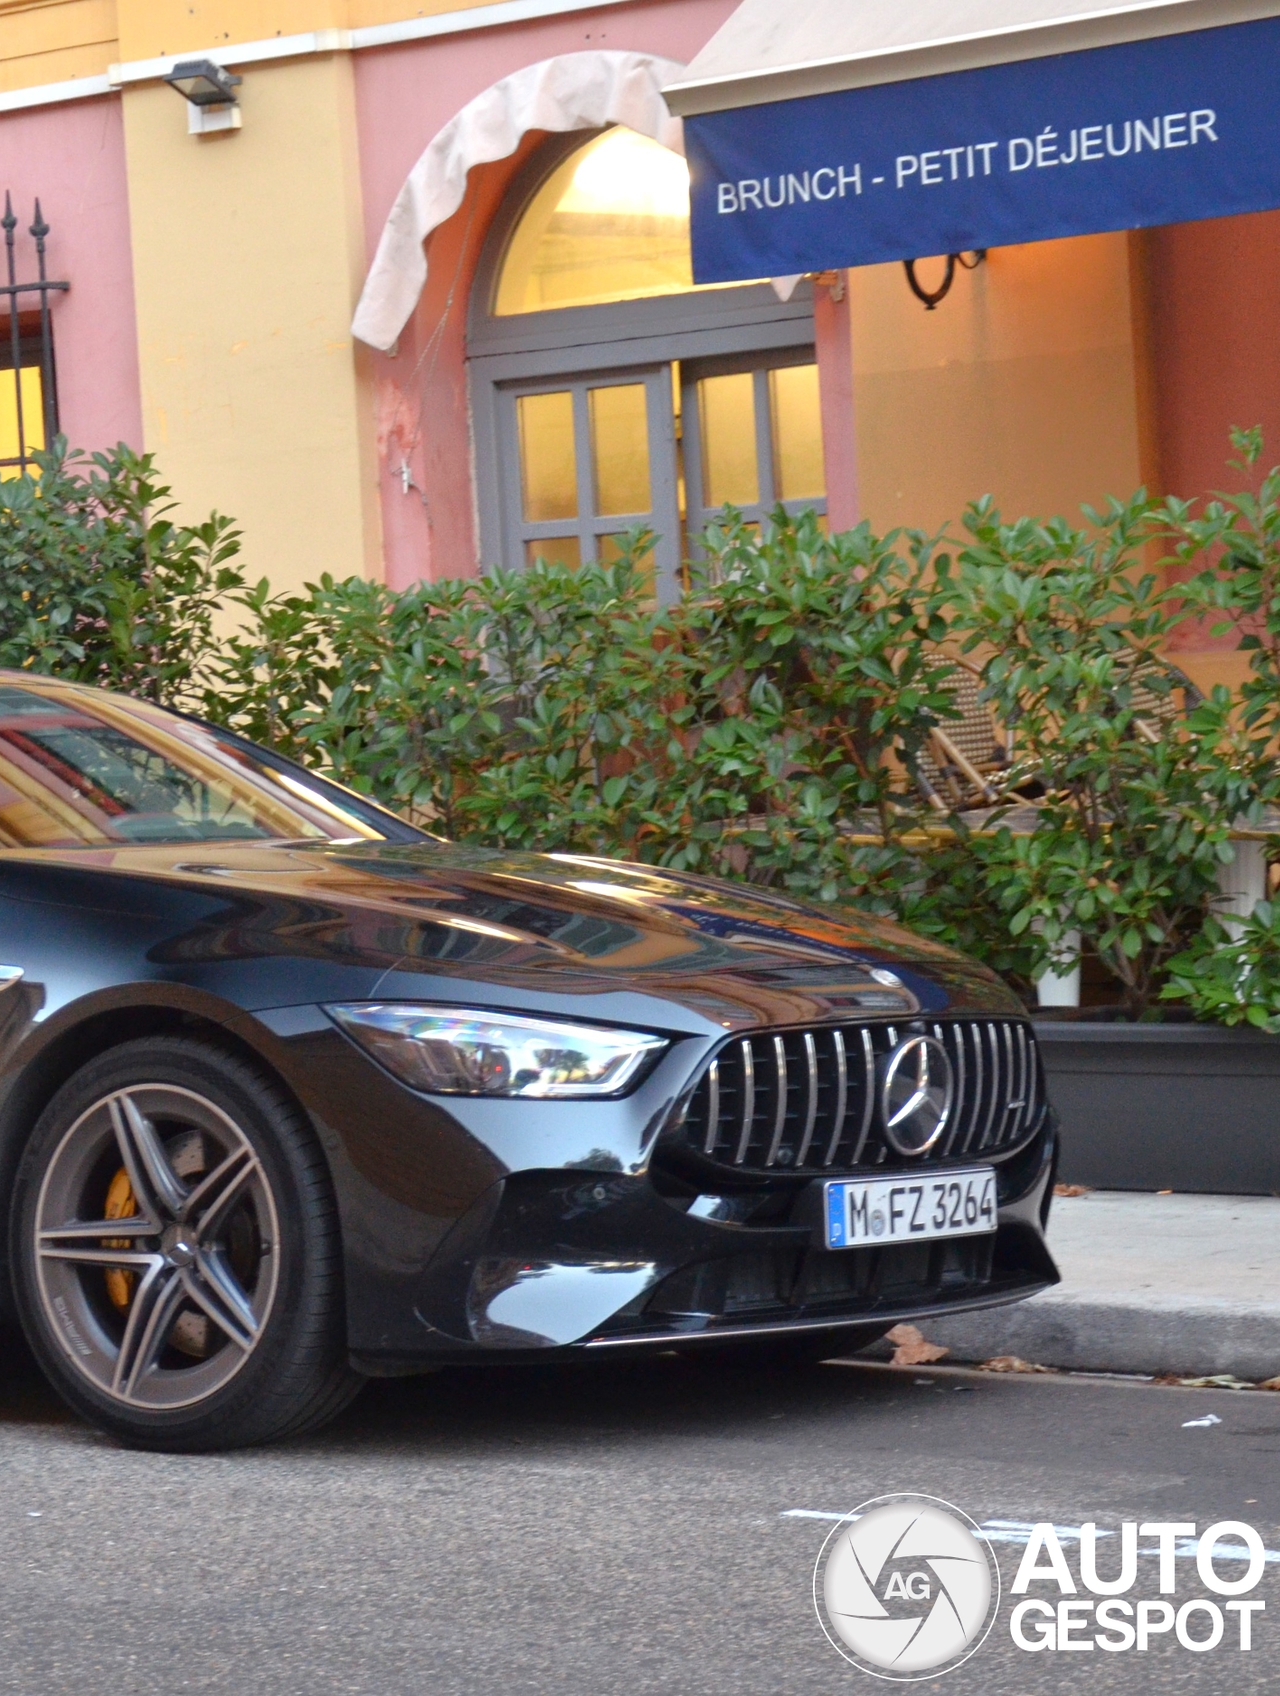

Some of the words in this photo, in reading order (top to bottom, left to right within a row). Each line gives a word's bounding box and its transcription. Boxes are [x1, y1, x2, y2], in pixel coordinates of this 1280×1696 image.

[717, 163, 863, 214] BRUNCH
[895, 141, 998, 189] PETIT
[1008, 108, 1219, 173] DÉJEUNER
[848, 1190, 869, 1238] M
